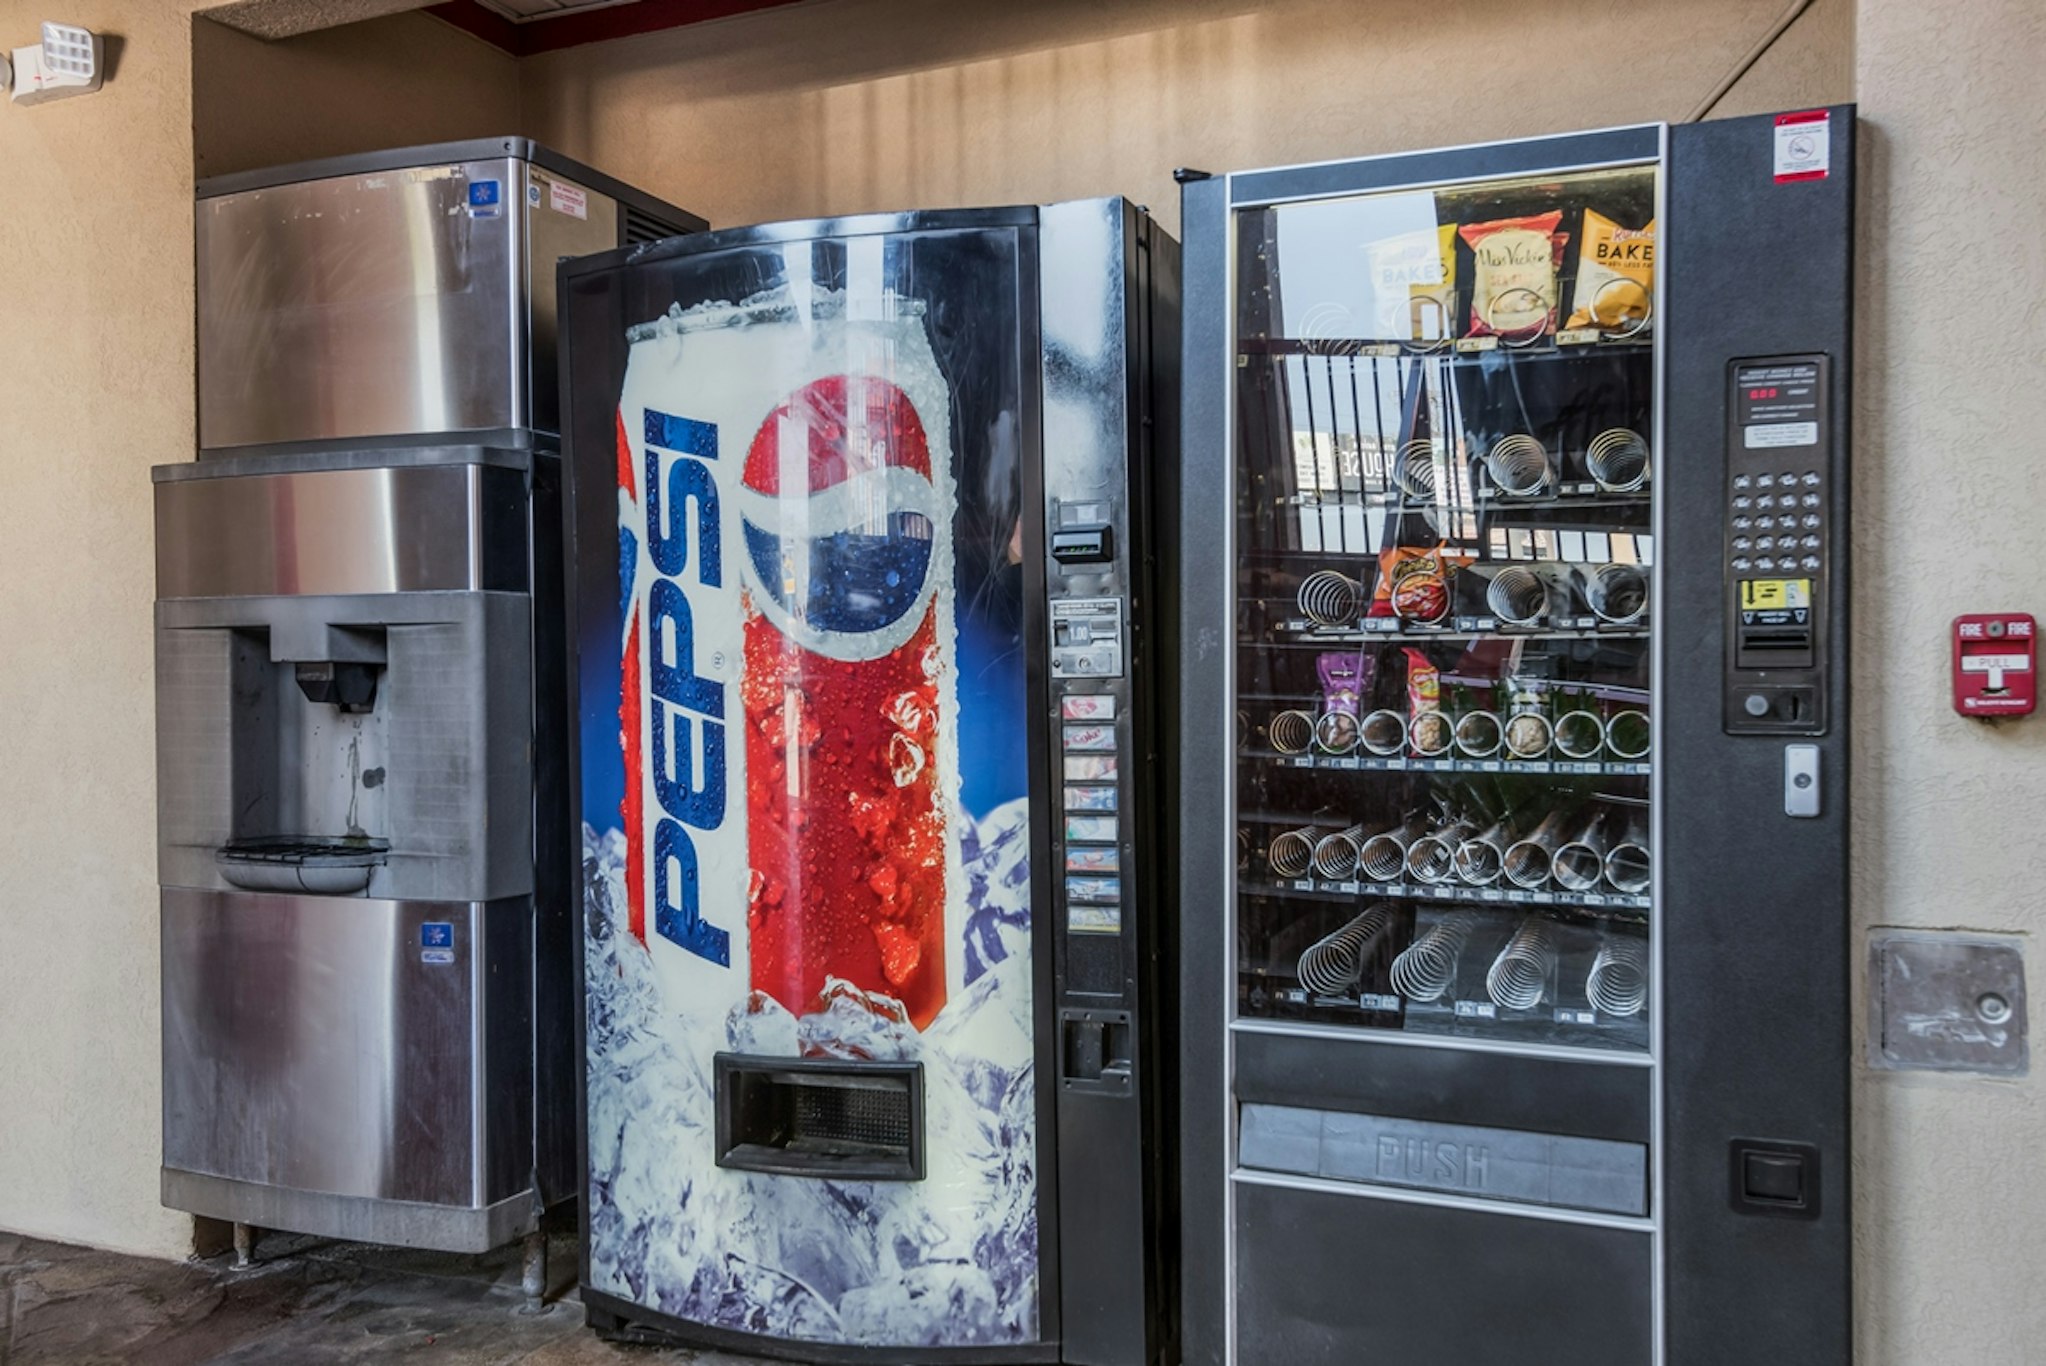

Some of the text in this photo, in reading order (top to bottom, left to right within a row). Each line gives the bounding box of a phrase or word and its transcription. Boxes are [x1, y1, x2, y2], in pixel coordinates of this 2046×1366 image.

[1959, 623, 1983, 637] FIRE
[2007, 622, 2032, 635] FIRE
[1978, 657, 2011, 668] PULL
[644, 407, 730, 969] PEPSI
[1376, 1134, 1488, 1187] PUSH
